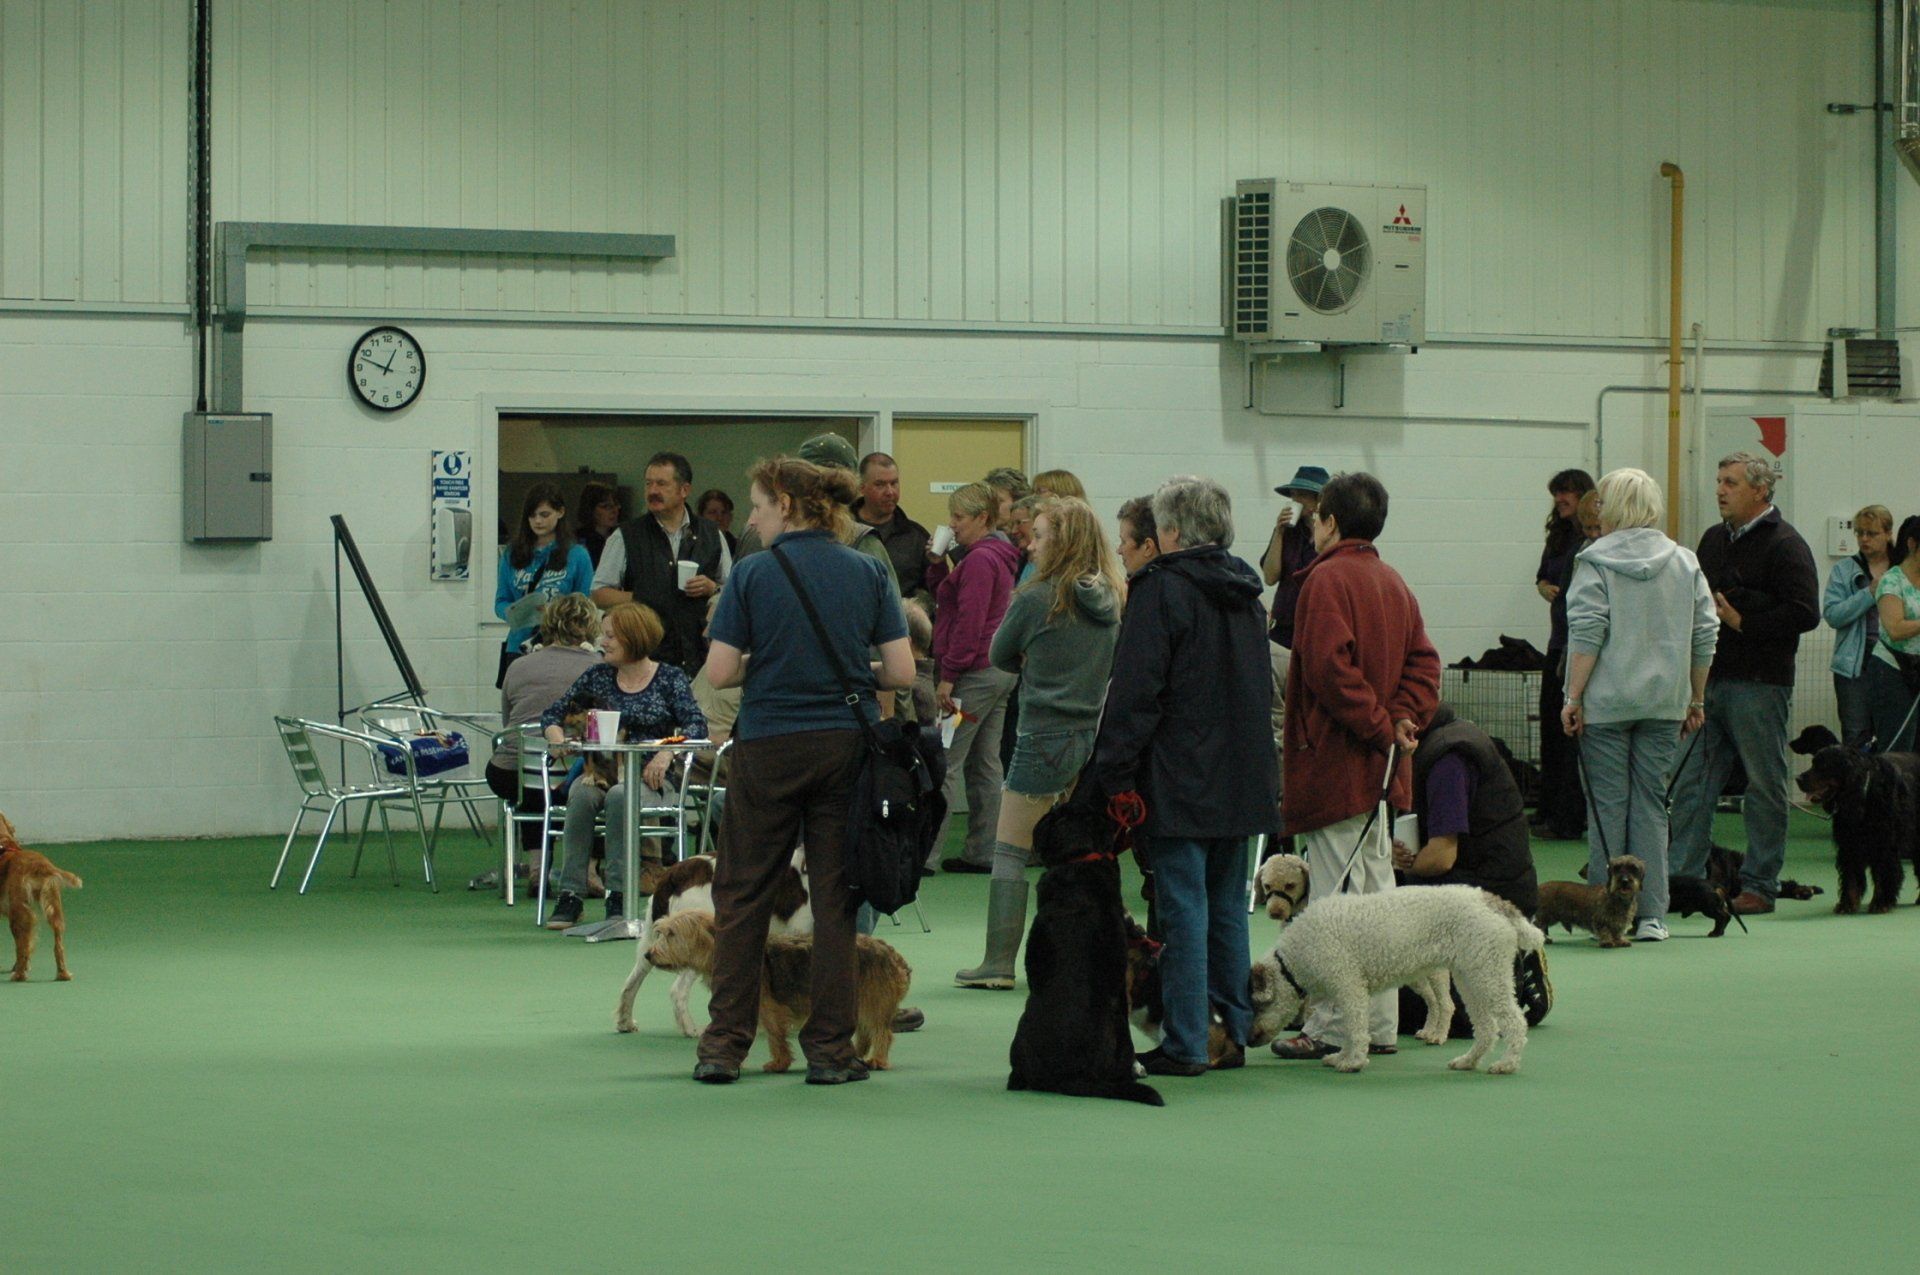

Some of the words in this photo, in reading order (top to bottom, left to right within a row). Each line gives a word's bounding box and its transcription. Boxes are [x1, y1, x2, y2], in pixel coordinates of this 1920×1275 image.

[370, 339, 380, 347] 11
[382, 335, 393, 343] 12
[361, 349, 372, 357] 10
[406, 351, 413, 359] 2
[356, 364, 363, 372] 9
[410, 366, 417, 374] 3
[360, 379, 367, 387] 8
[383, 395, 389, 403] 6
[396, 391, 402, 399] 5
